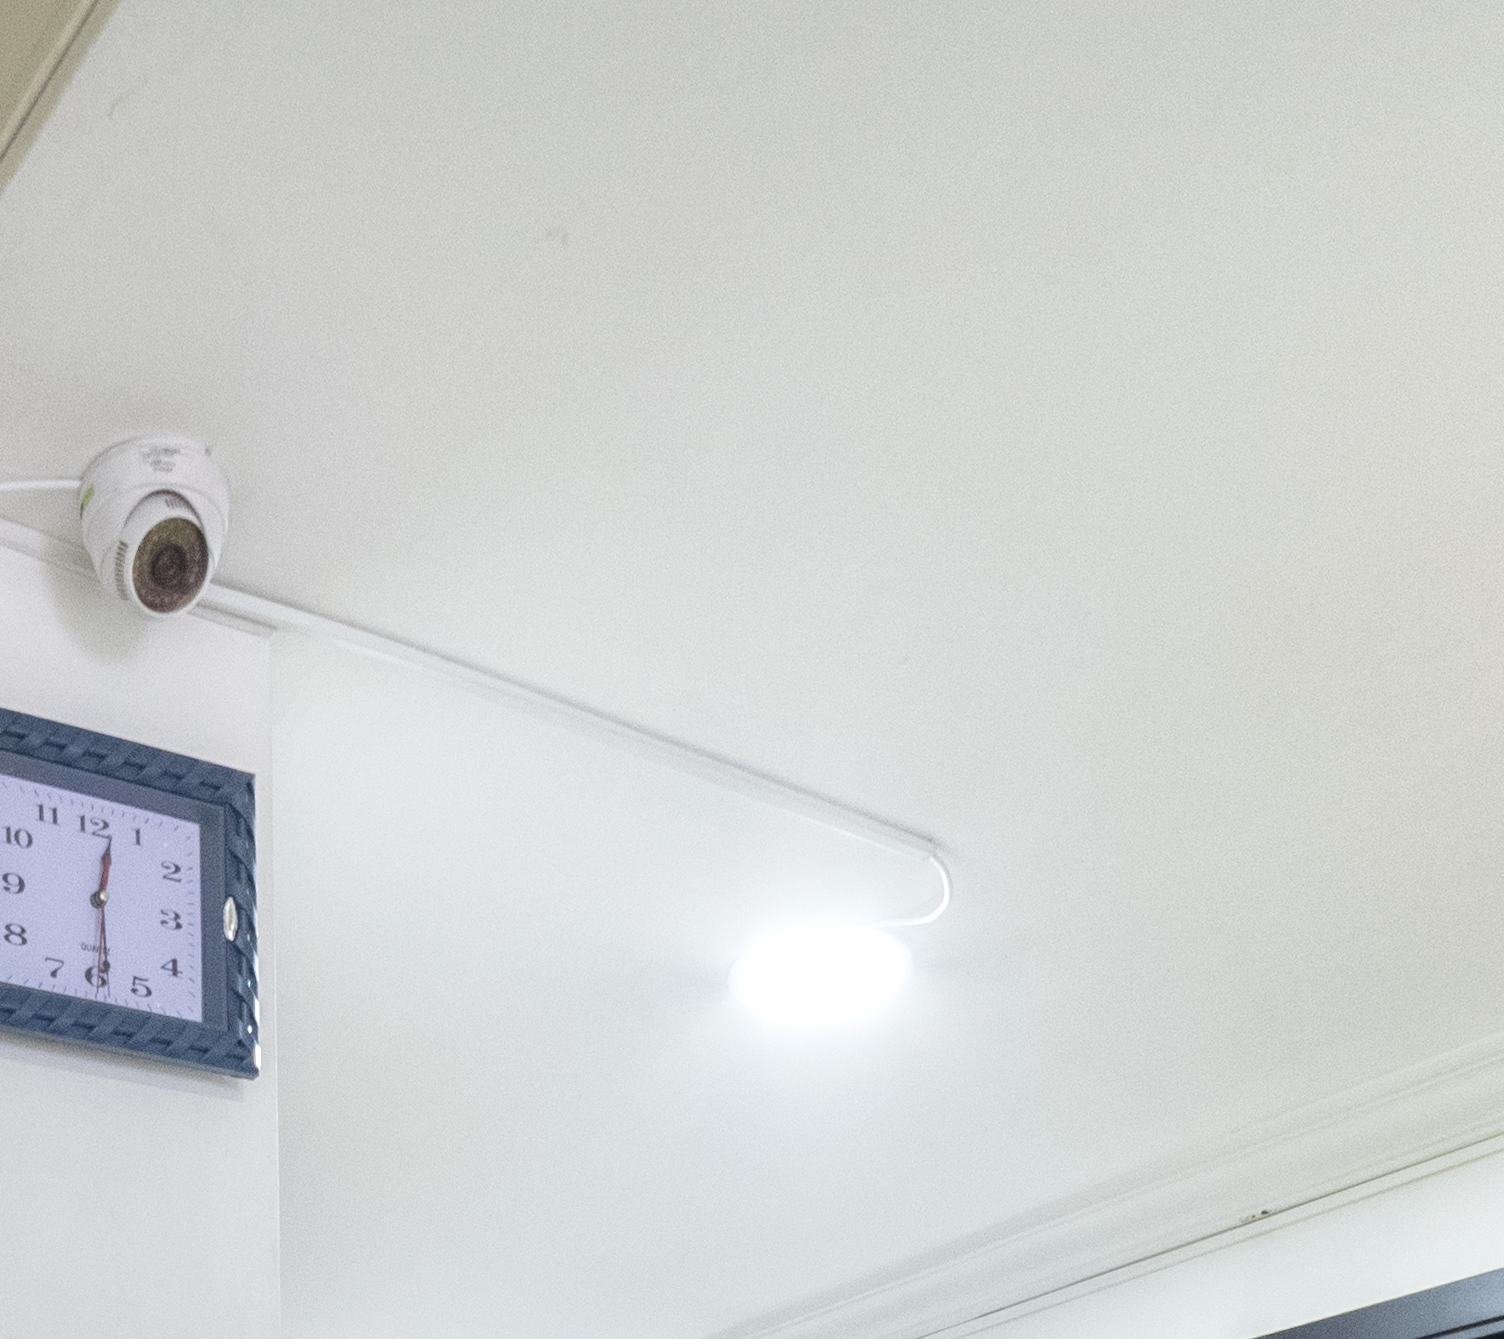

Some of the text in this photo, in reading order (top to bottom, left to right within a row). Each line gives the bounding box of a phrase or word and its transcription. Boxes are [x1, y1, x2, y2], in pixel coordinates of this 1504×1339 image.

[35, 804, 60, 825] 11
[2, 826, 33, 848] 10
[77, 815, 111, 839] 12
[132, 829, 143, 846] 1
[162, 861, 182, 882] 2
[3, 872, 25, 894] 9
[161, 910, 183, 930] 3
[4, 923, 27, 946] 8
[45, 957, 64, 978] 7
[162, 958, 183, 976] 4
[131, 976, 152, 998] 5
